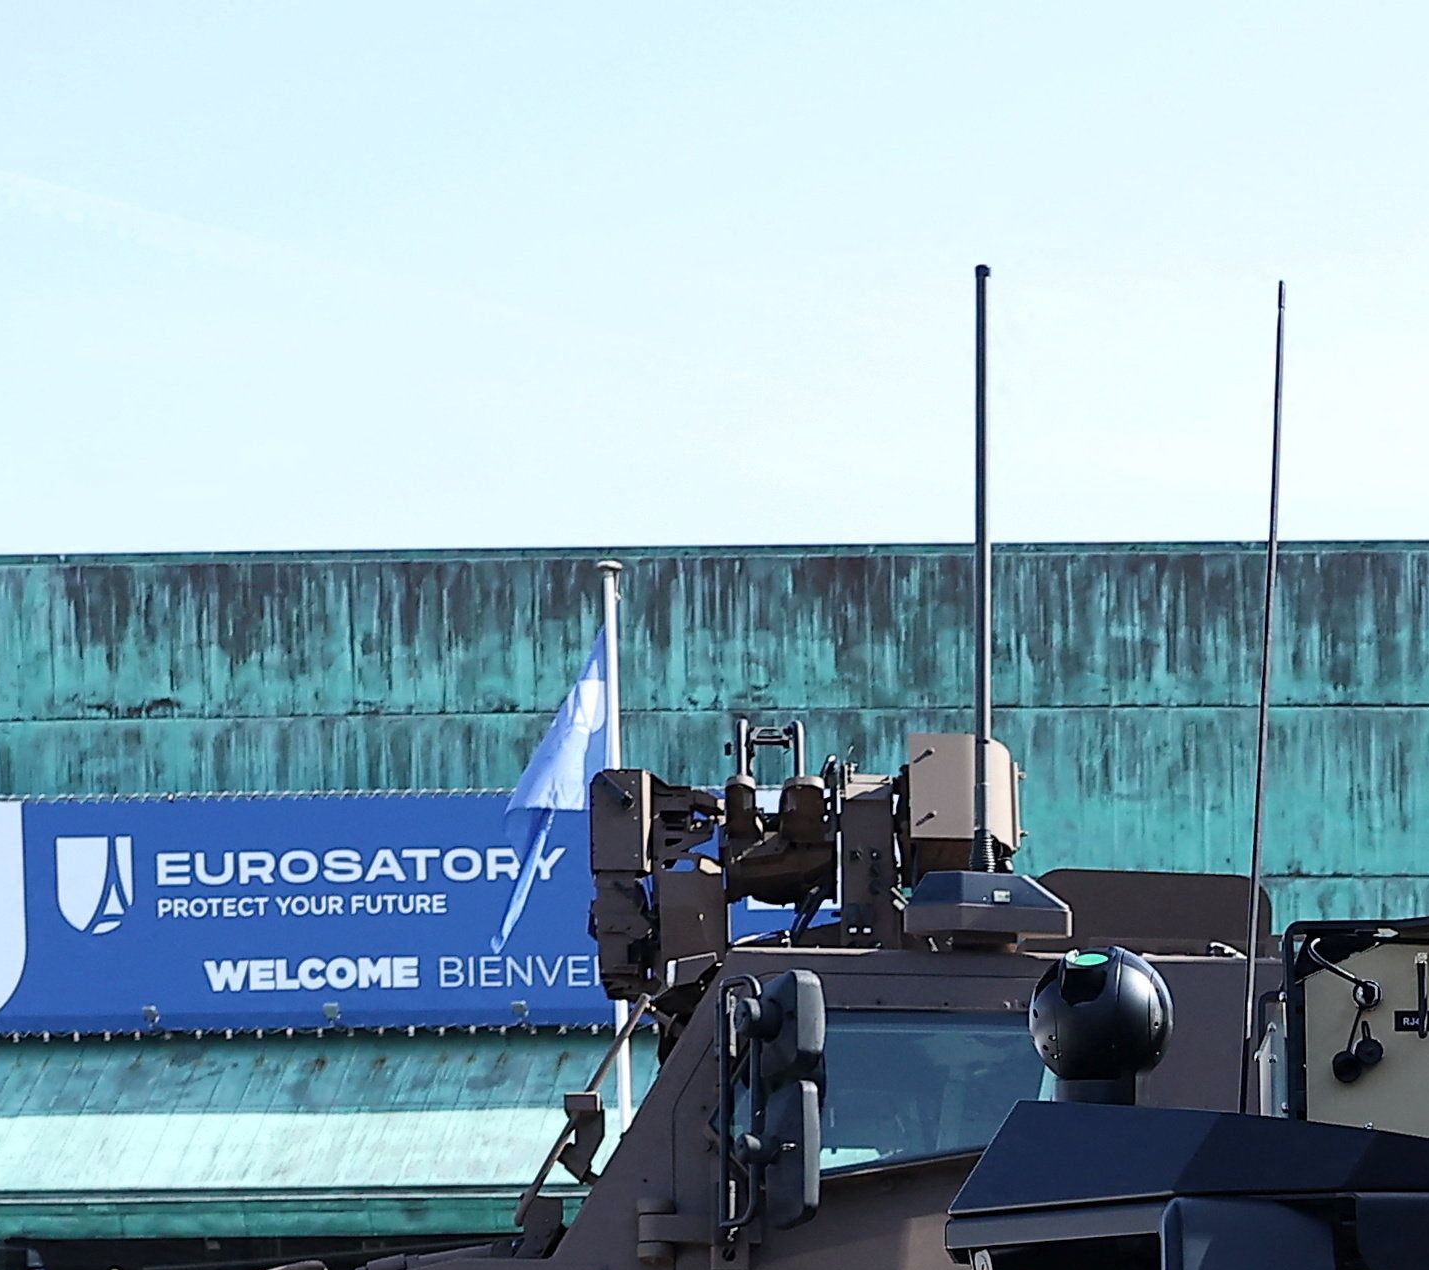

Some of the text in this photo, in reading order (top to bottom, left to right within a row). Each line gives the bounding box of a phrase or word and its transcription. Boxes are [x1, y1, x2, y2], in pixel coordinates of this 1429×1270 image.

[156, 847, 566, 886] EUROSATORY
[157, 893, 447, 918] PROTECT YOUR FUTURE
[204, 955, 600, 992] WELCOME BIENVE
[1403, 1017, 1420, 1026] RJ4
